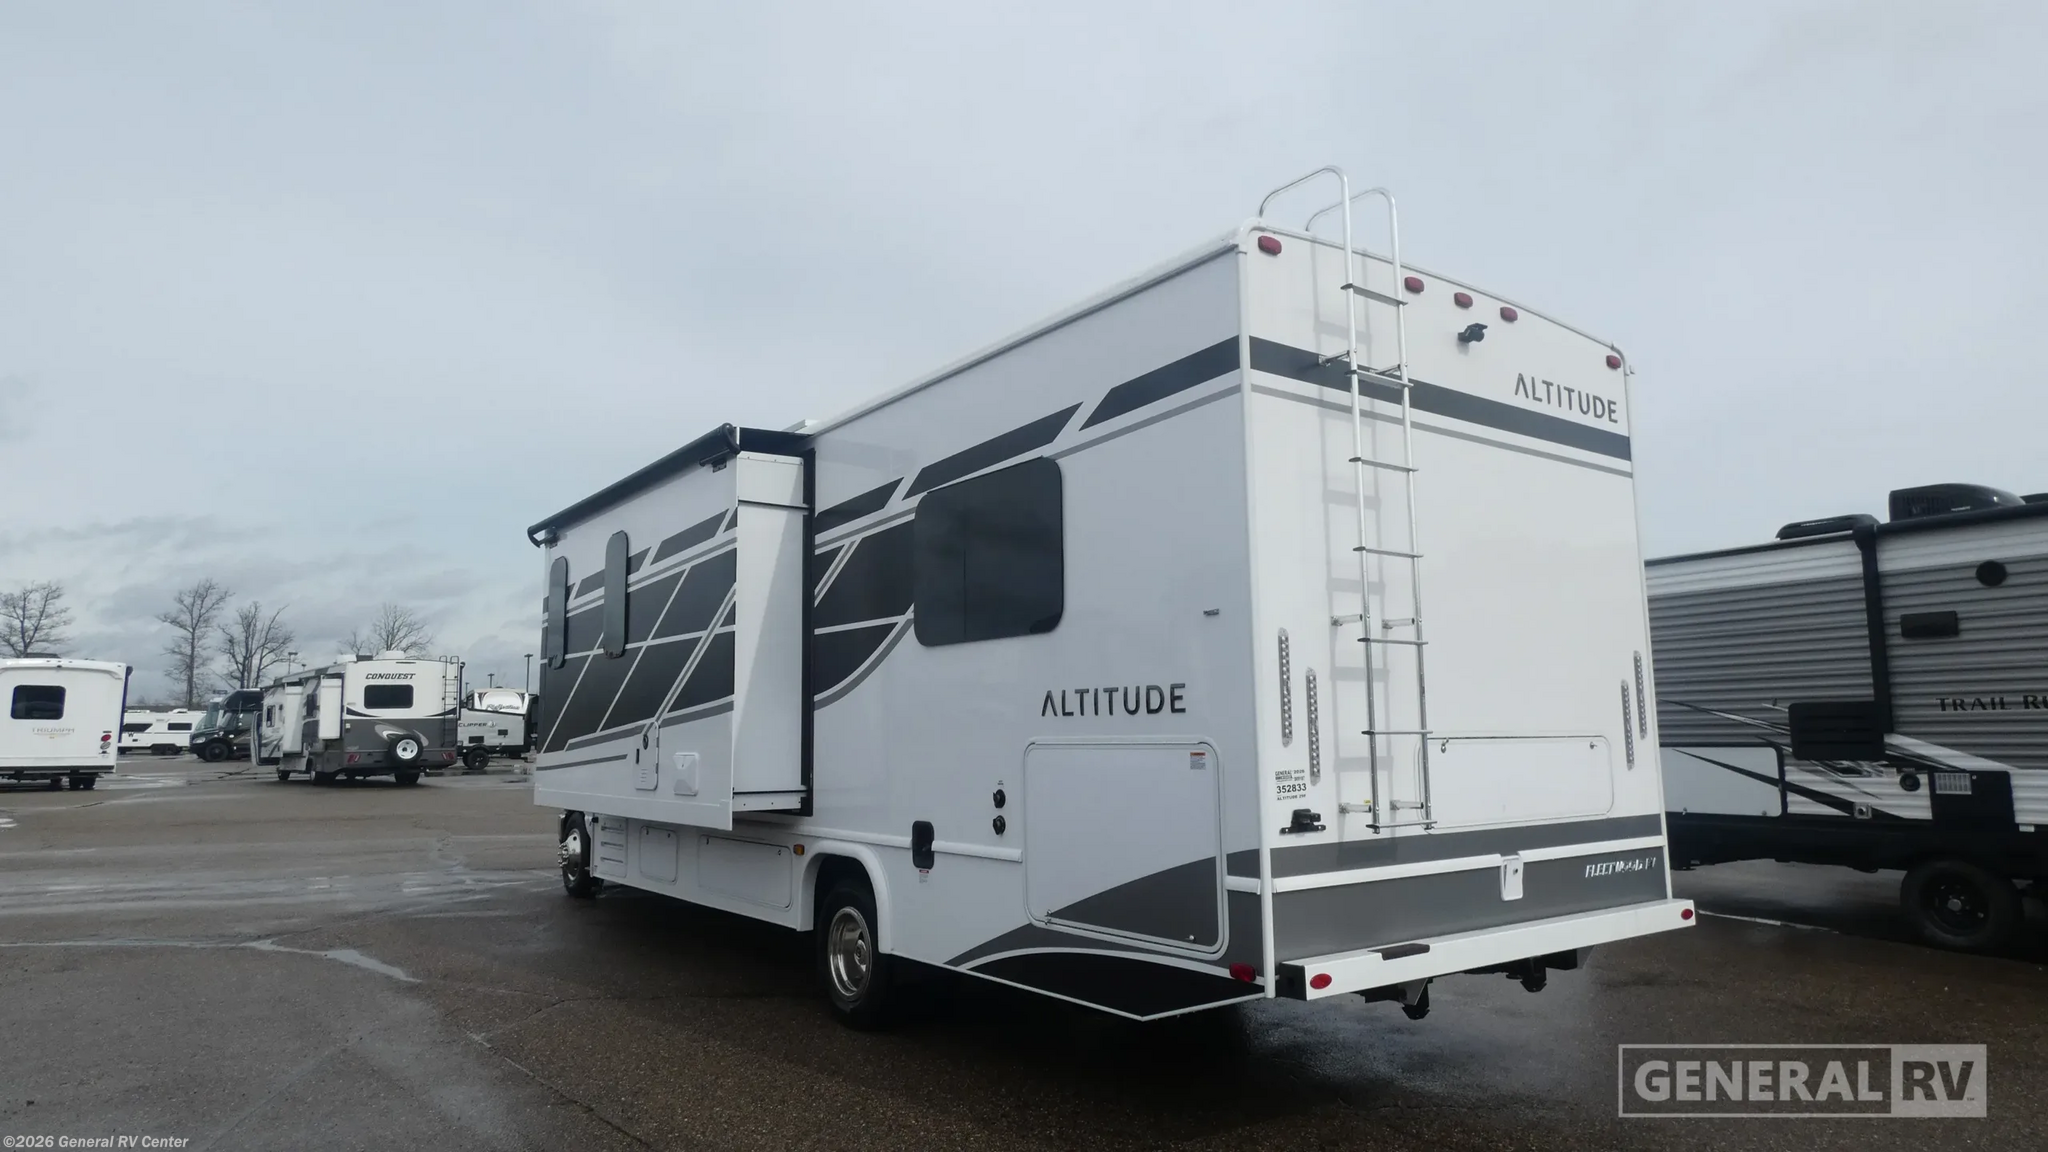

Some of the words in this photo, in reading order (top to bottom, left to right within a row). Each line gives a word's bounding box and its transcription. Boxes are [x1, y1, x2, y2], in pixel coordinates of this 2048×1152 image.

[1515, 373, 1618, 424] ALTITUDE
[1041, 683, 1186, 717] ALTITUDE
[1936, 697, 2012, 711] TRAIL
[1277, 783, 1307, 794] 352833
